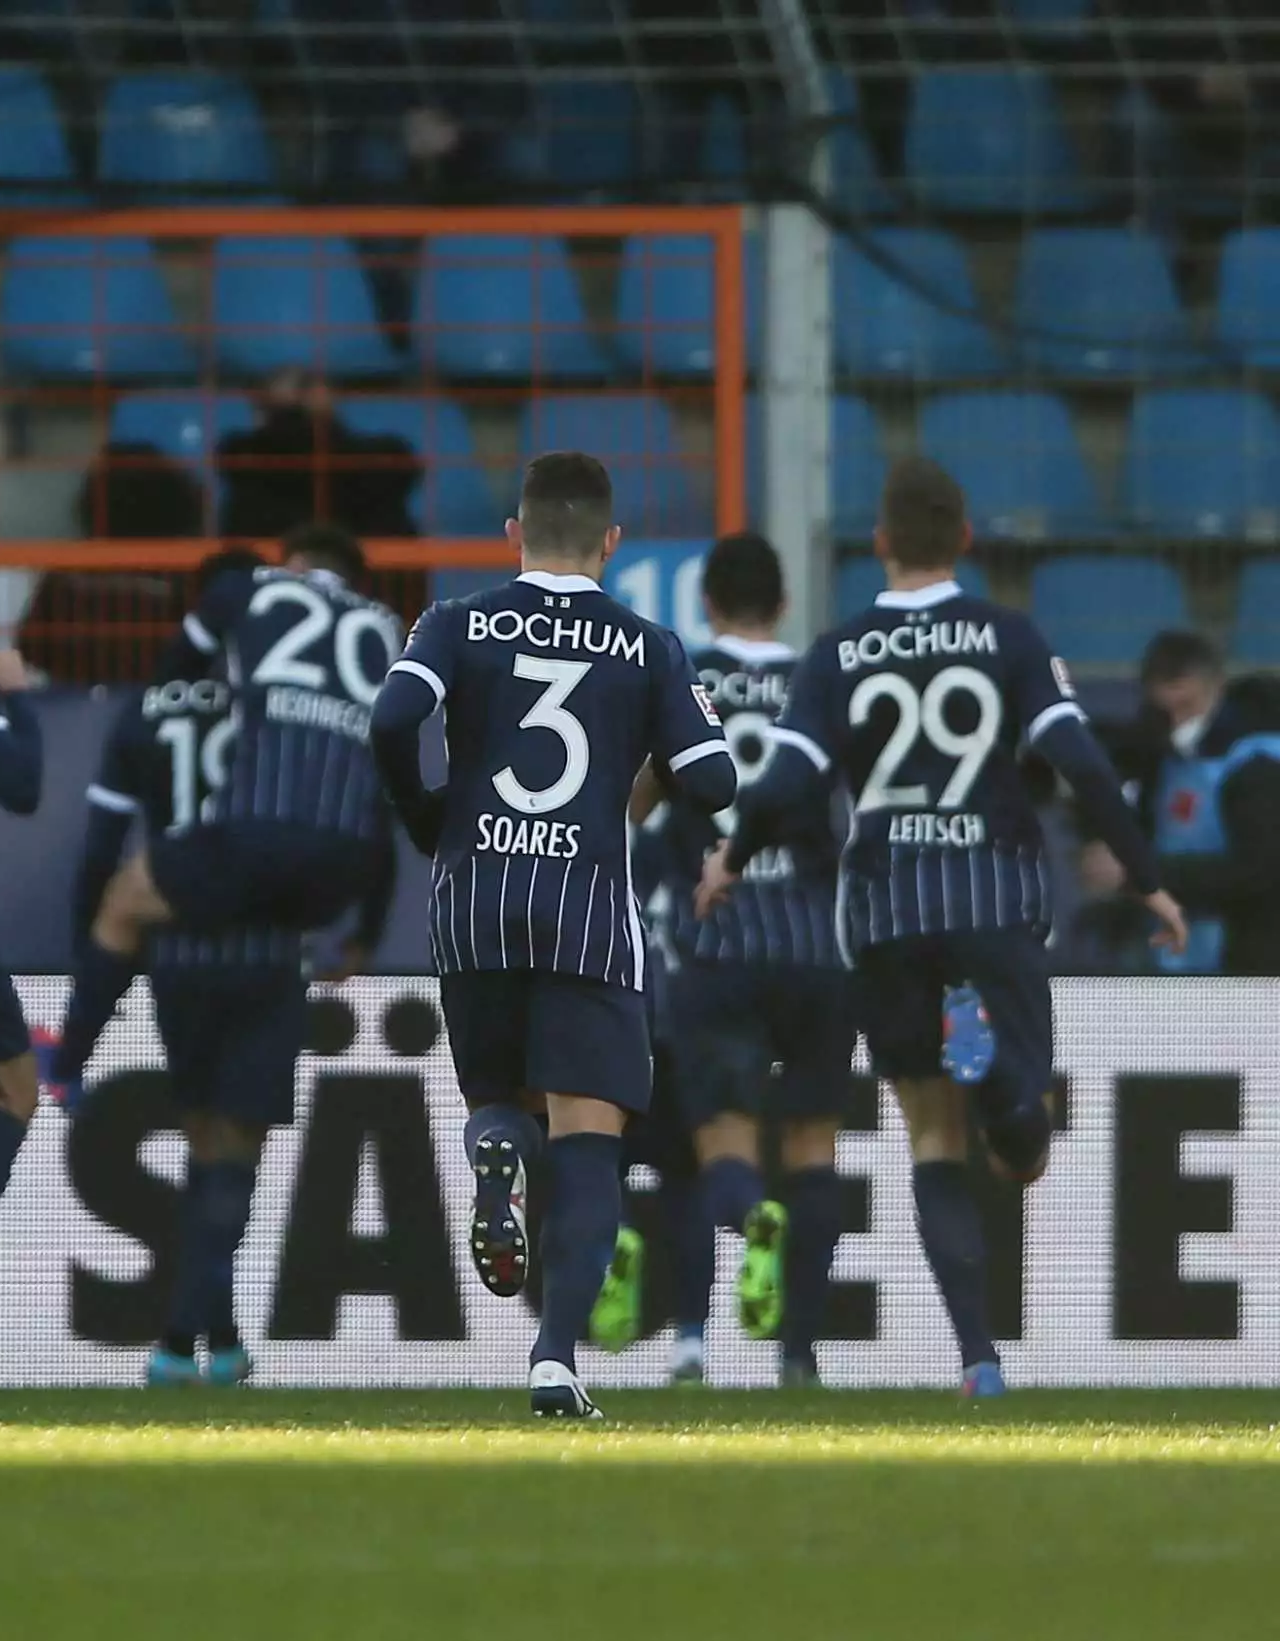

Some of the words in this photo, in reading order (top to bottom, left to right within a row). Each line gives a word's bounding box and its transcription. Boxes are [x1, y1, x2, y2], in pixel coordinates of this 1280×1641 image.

[248, 580, 403, 706] 20
[467, 609, 646, 667] BOCHUM
[837, 620, 999, 673] BOCHUM
[142, 679, 229, 721] BOC
[698, 668, 789, 708] OCHU
[492, 653, 593, 814] 3
[848, 665, 1002, 815] 29
[476, 812, 581, 859] SOARES
[888, 812, 986, 848] LEITSCH
[67, 995, 1243, 1343] SÄEE
